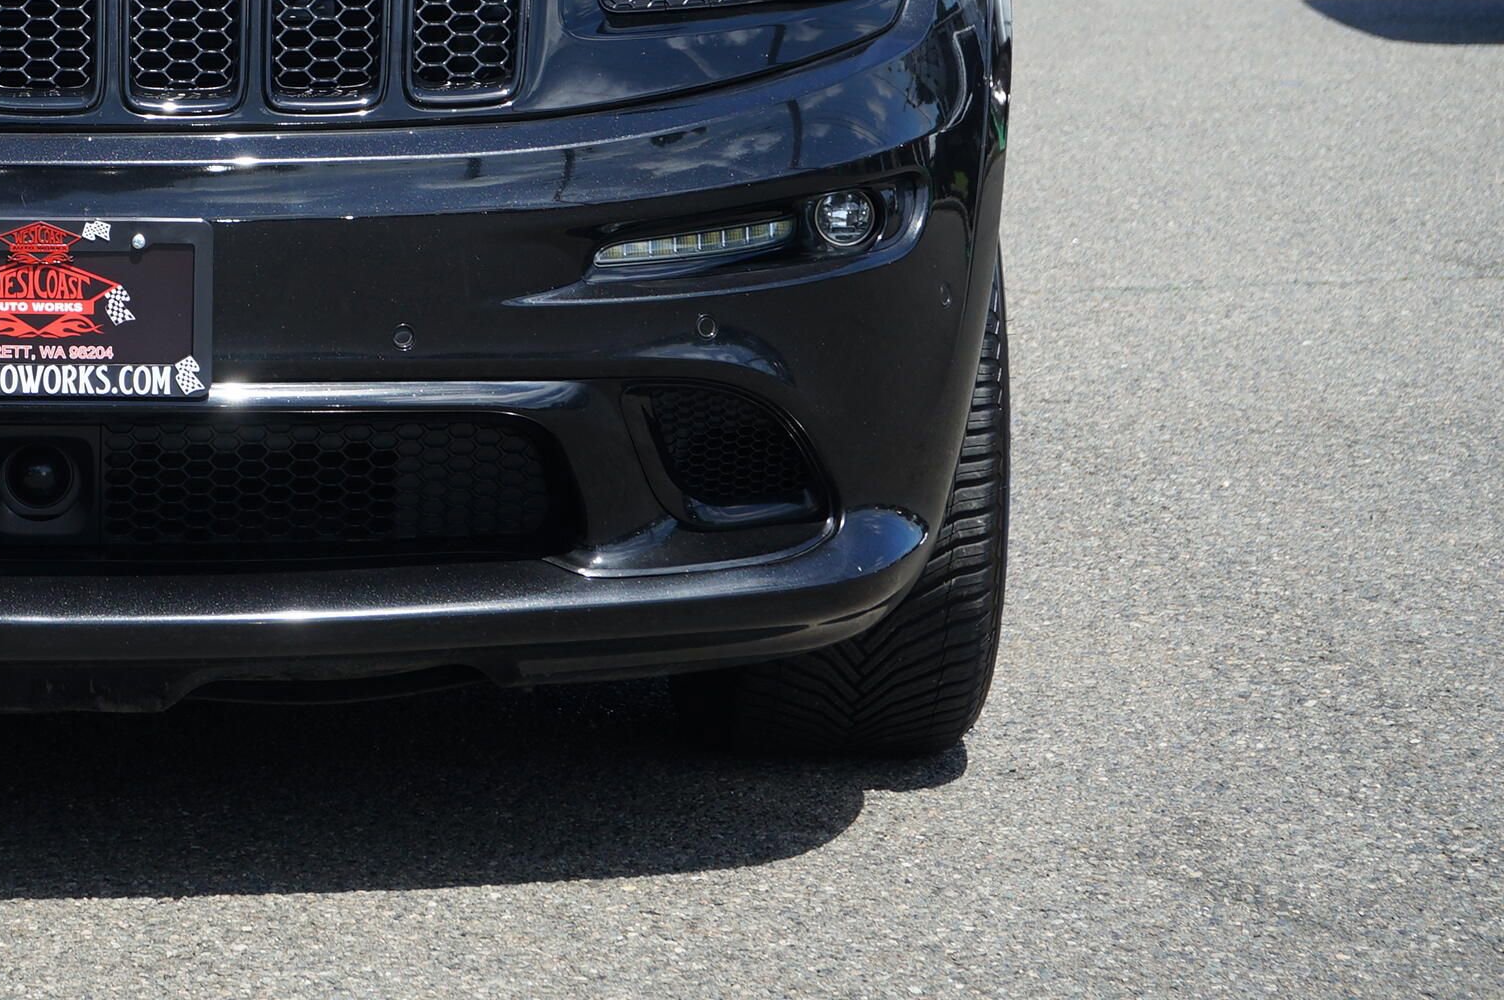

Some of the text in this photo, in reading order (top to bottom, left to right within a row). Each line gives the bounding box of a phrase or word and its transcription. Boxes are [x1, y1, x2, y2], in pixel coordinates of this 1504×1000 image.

[31, 302, 84, 313] WORKS
[38, 345, 67, 360] WA
[69, 345, 114, 360] 98204
